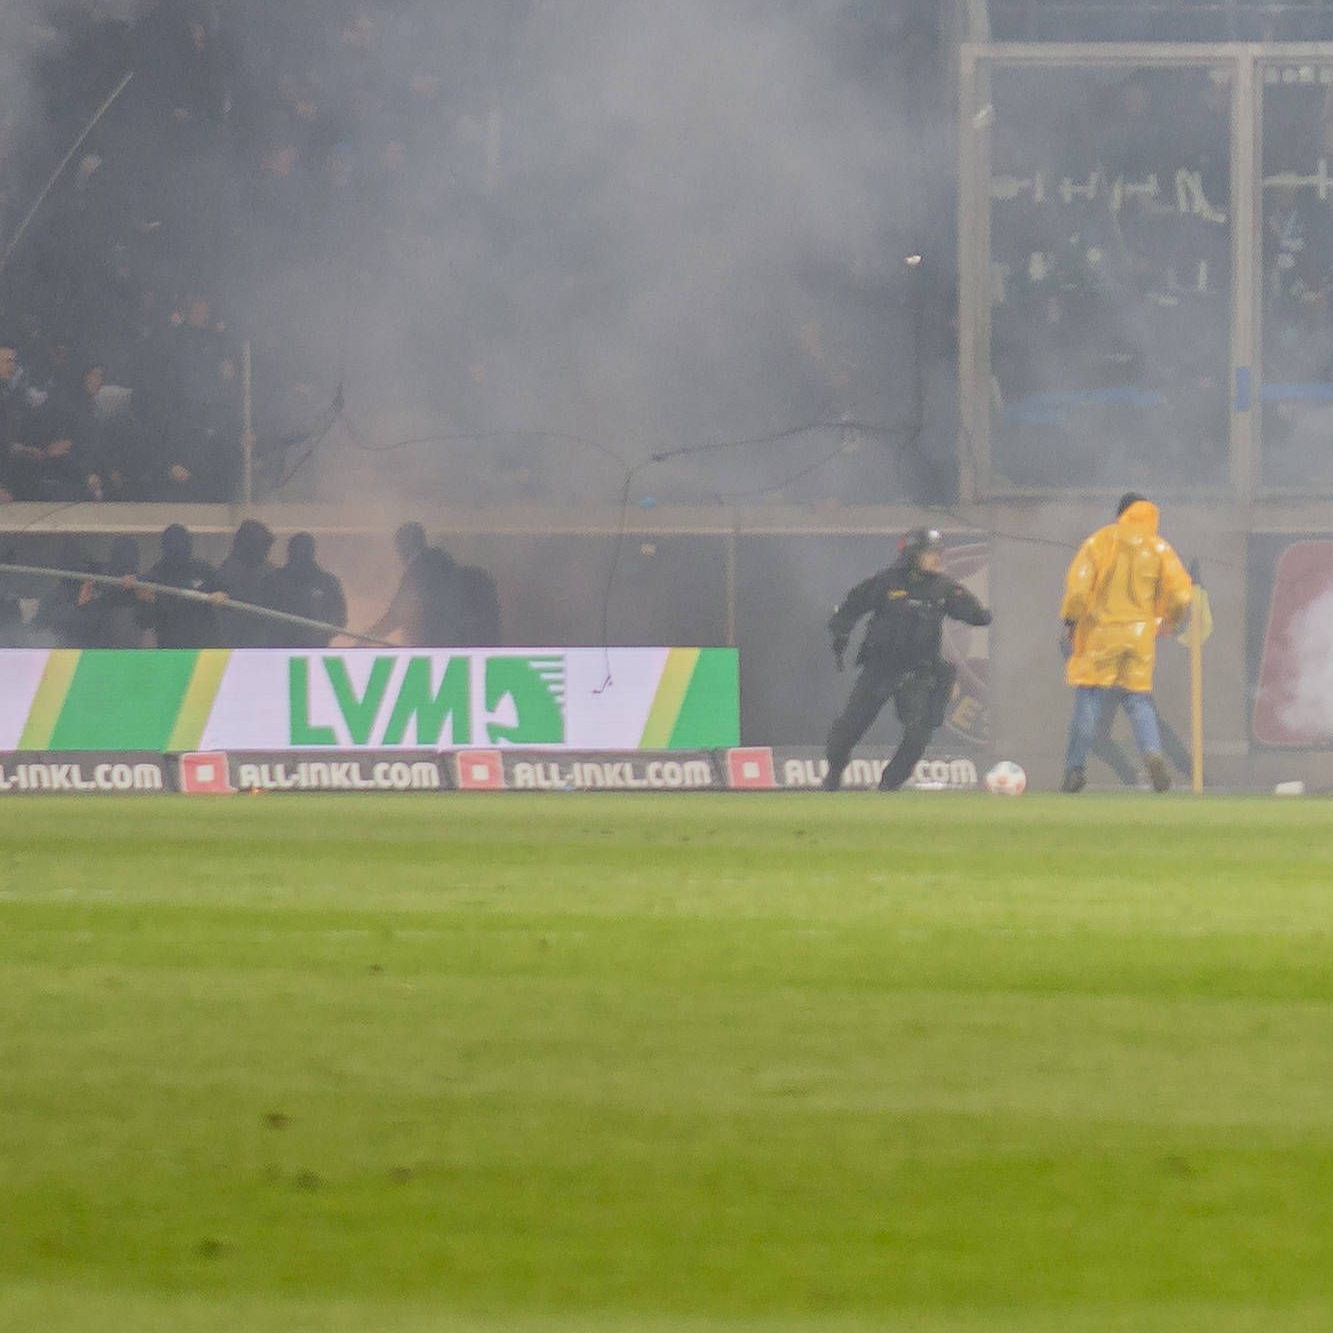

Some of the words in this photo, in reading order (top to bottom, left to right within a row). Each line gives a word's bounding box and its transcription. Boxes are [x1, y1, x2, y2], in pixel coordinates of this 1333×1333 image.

[289, 656, 472, 744] LVM
[240, 763, 439, 789] ALL-INKL.COM
[514, 762, 711, 788] ALL-INKL.COM
